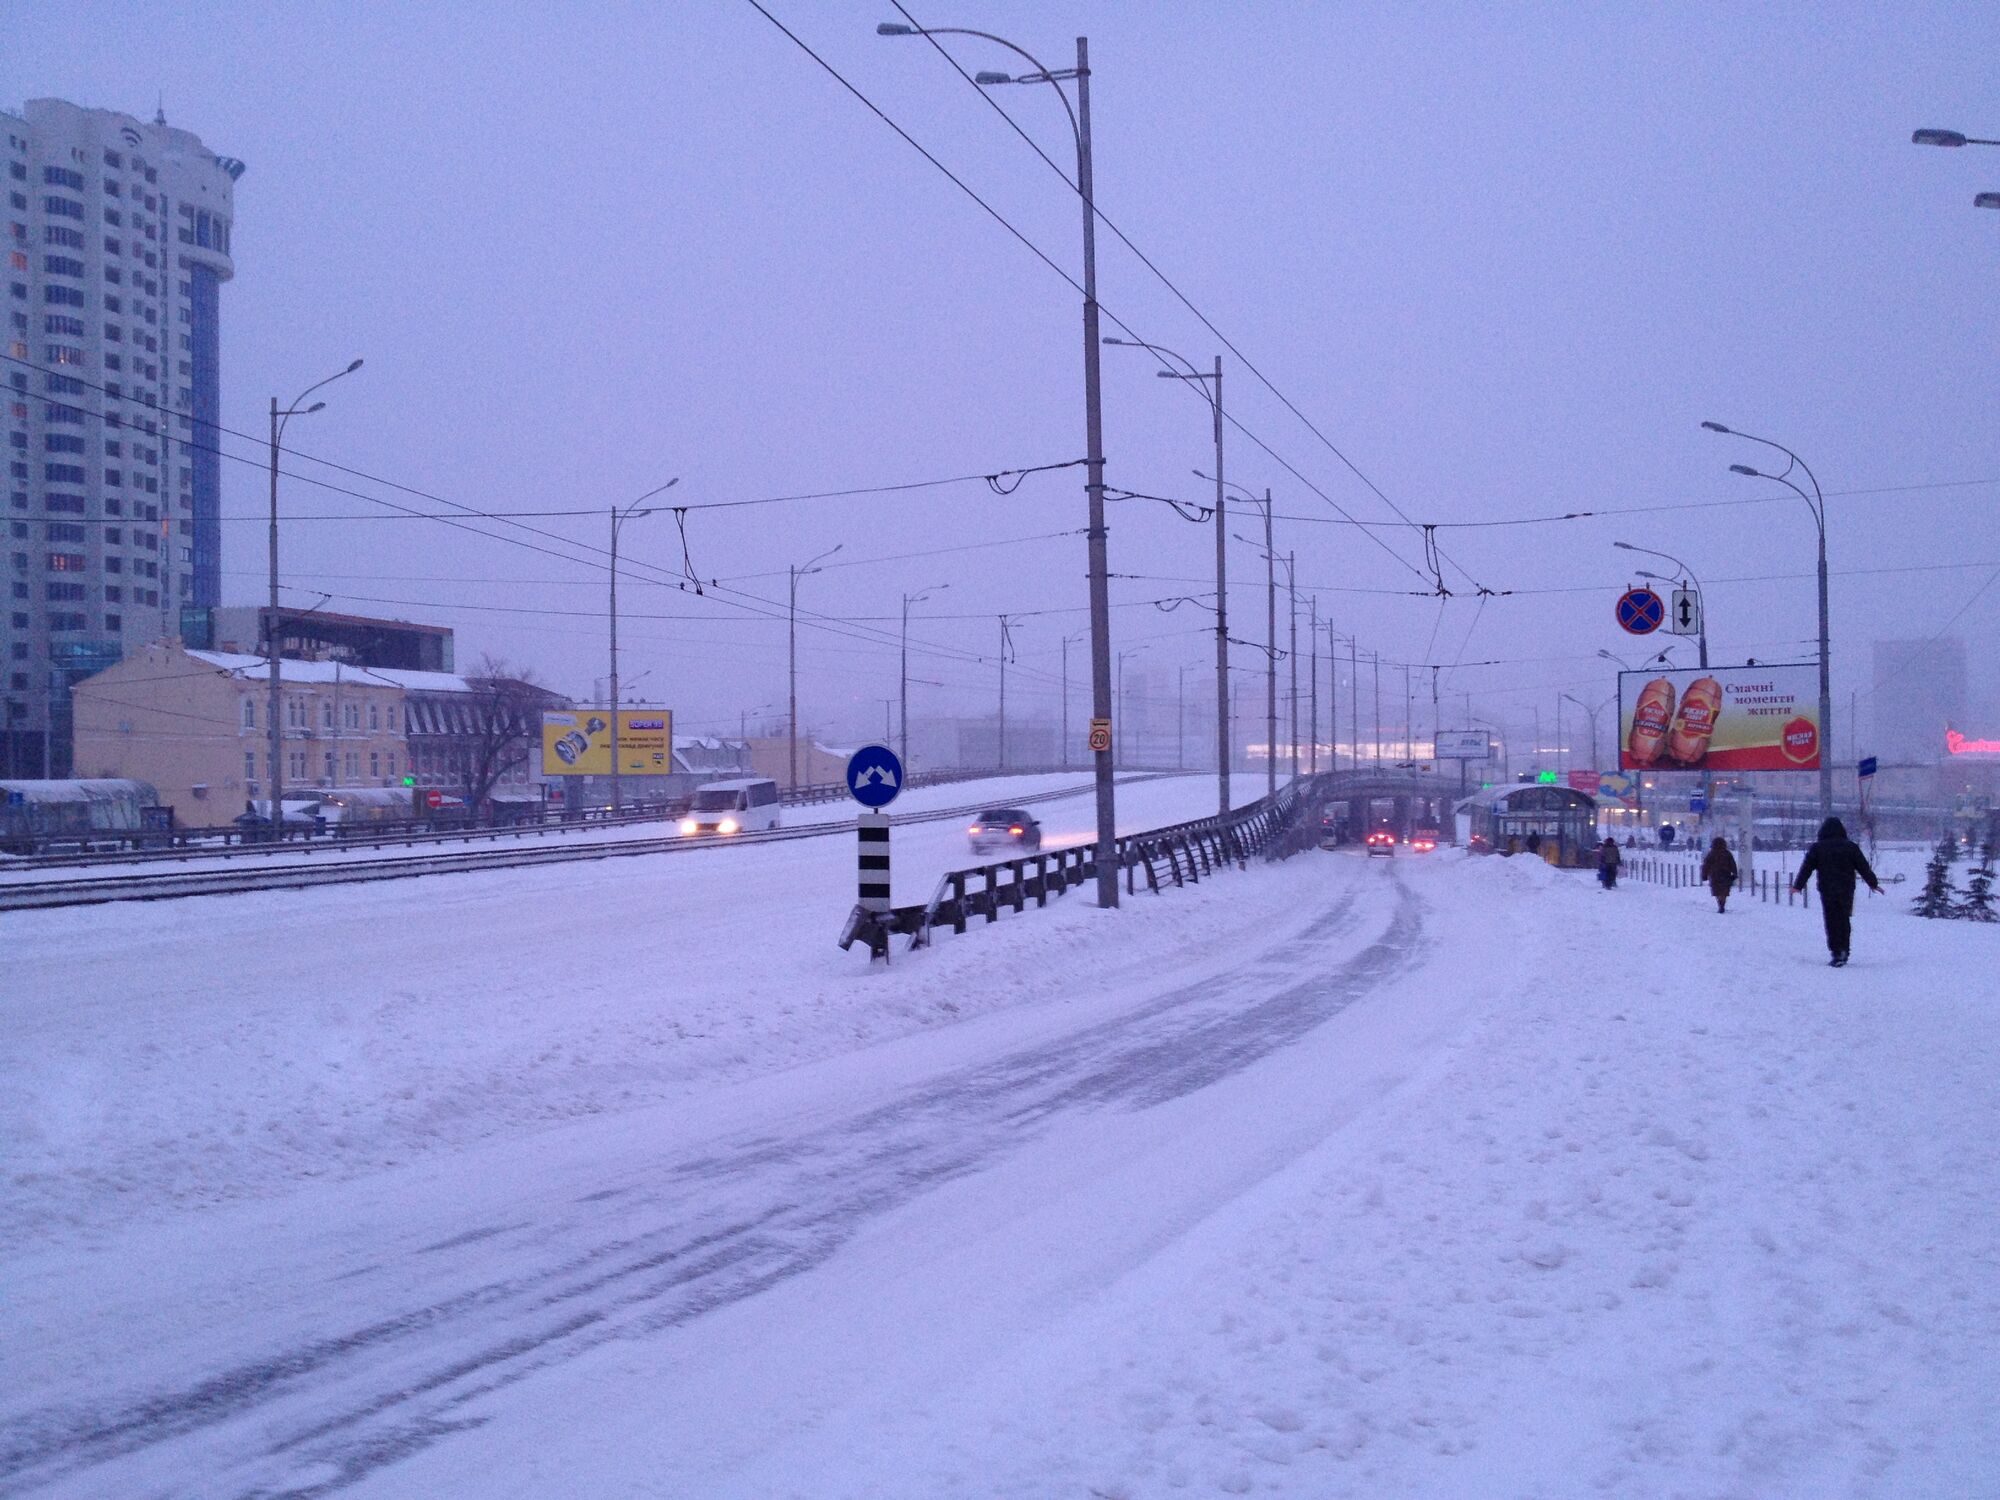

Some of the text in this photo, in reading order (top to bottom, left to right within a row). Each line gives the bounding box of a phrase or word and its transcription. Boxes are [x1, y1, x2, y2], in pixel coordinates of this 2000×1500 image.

[1725, 681, 1774, 694] Смачні
[1735, 695, 1795, 705] моменти
[1747, 707, 1792, 716] життя
[1093, 733, 1106, 744] 20
